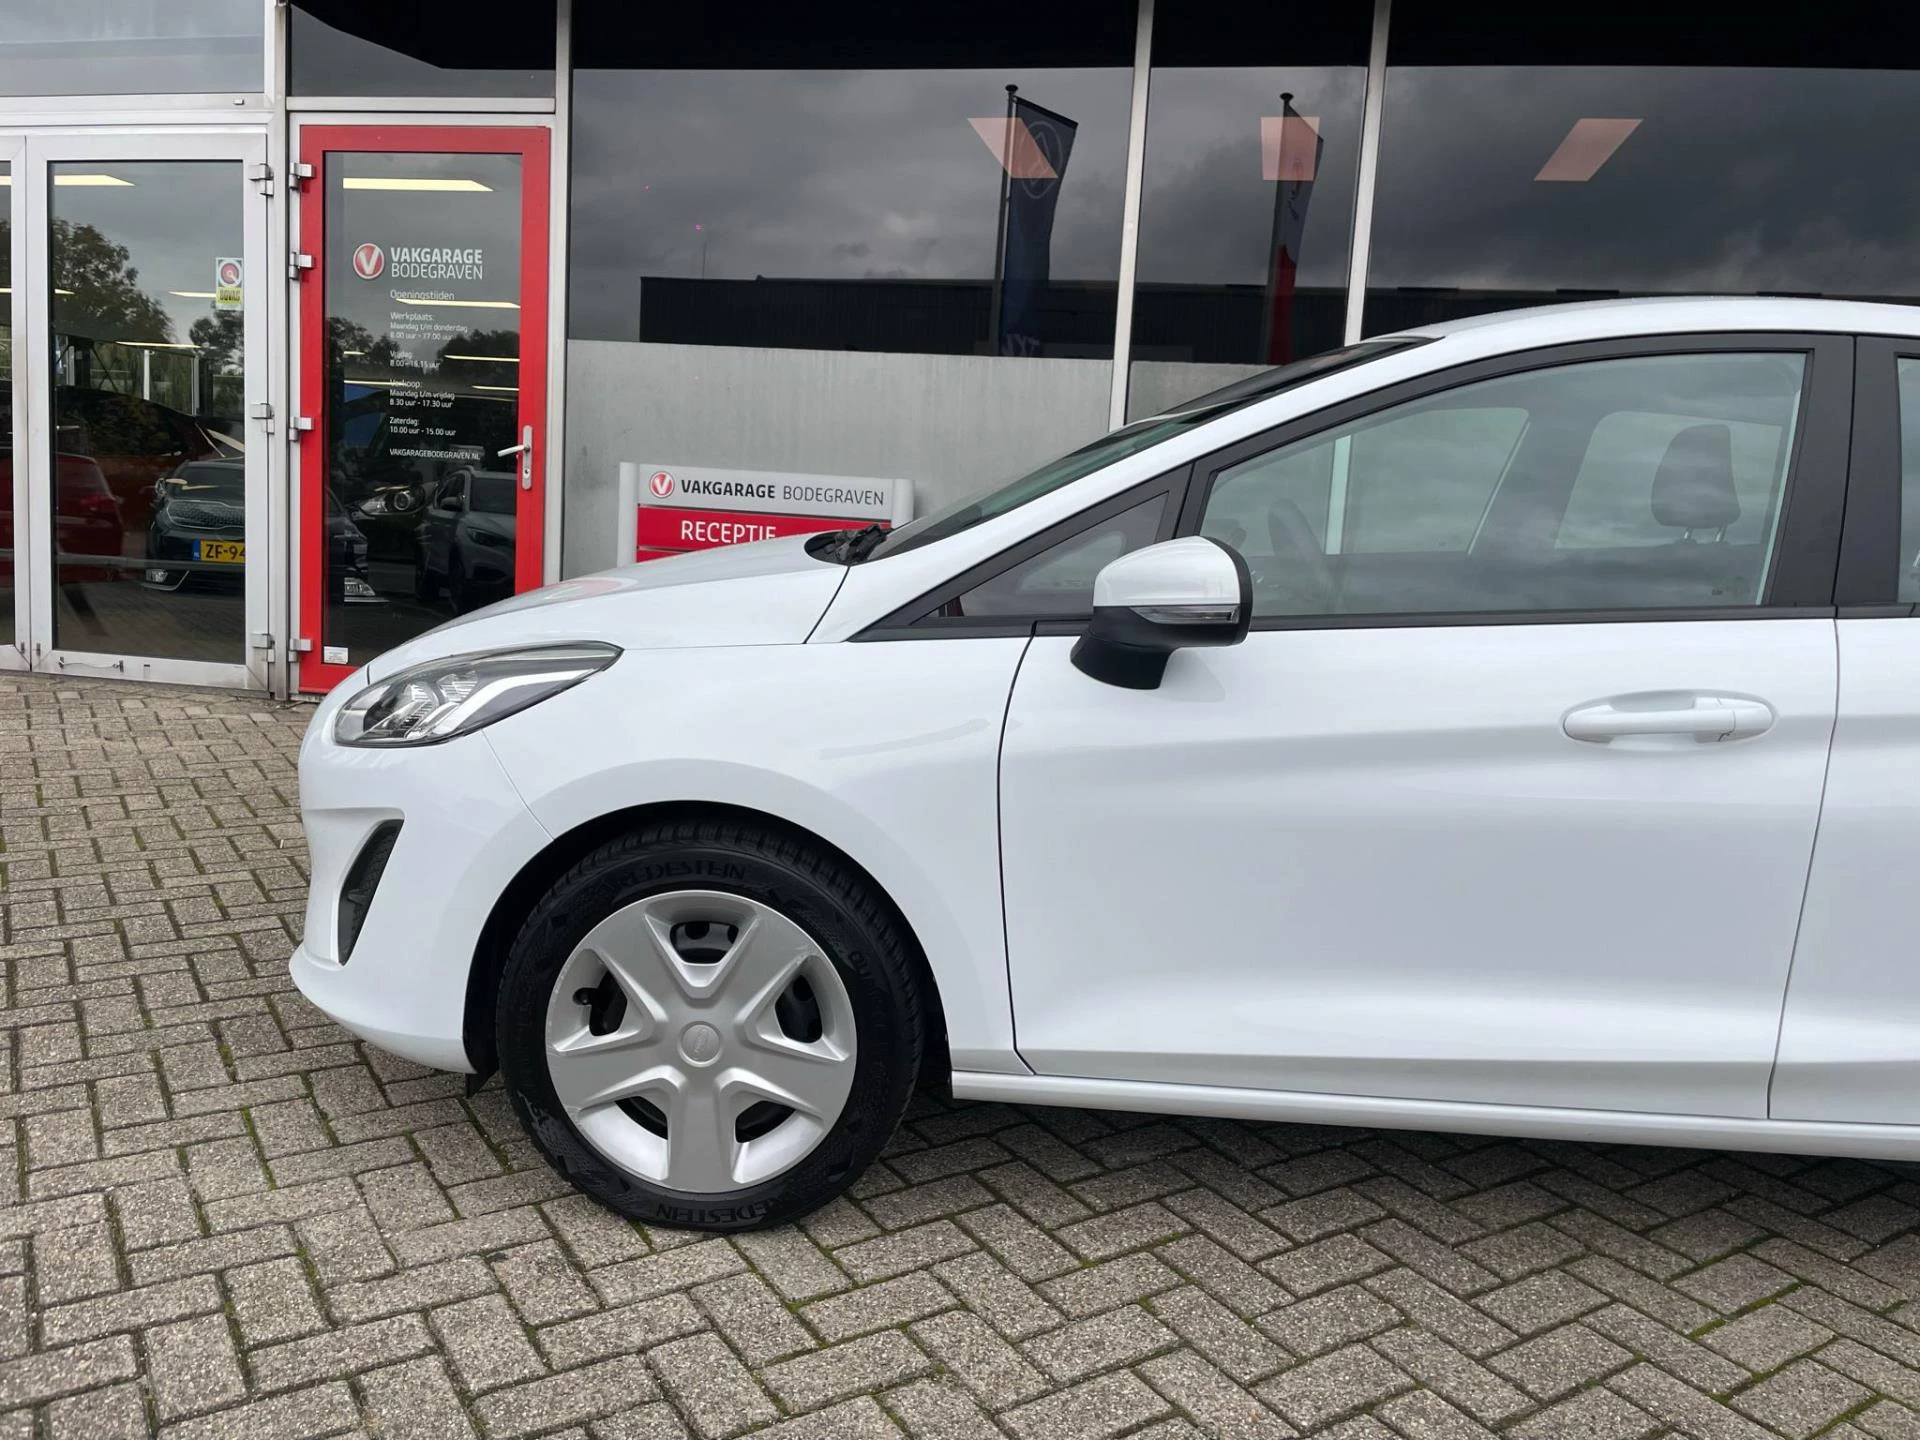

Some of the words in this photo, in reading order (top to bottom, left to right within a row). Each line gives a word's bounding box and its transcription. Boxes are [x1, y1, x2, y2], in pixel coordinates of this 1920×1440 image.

[390, 247, 483, 264] VAKGARAGE
[391, 263, 483, 280] BODEGRAVEN
[433, 324, 468, 333] donderdag
[390, 389, 419, 399] Maandag
[422, 400, 440, 408] 17.30
[390, 426, 408, 434] 10.00
[426, 428, 444, 436] 15.00
[681, 479, 776, 499] VAKGARAGE
[783, 485, 884, 506] BODEGRAVEN
